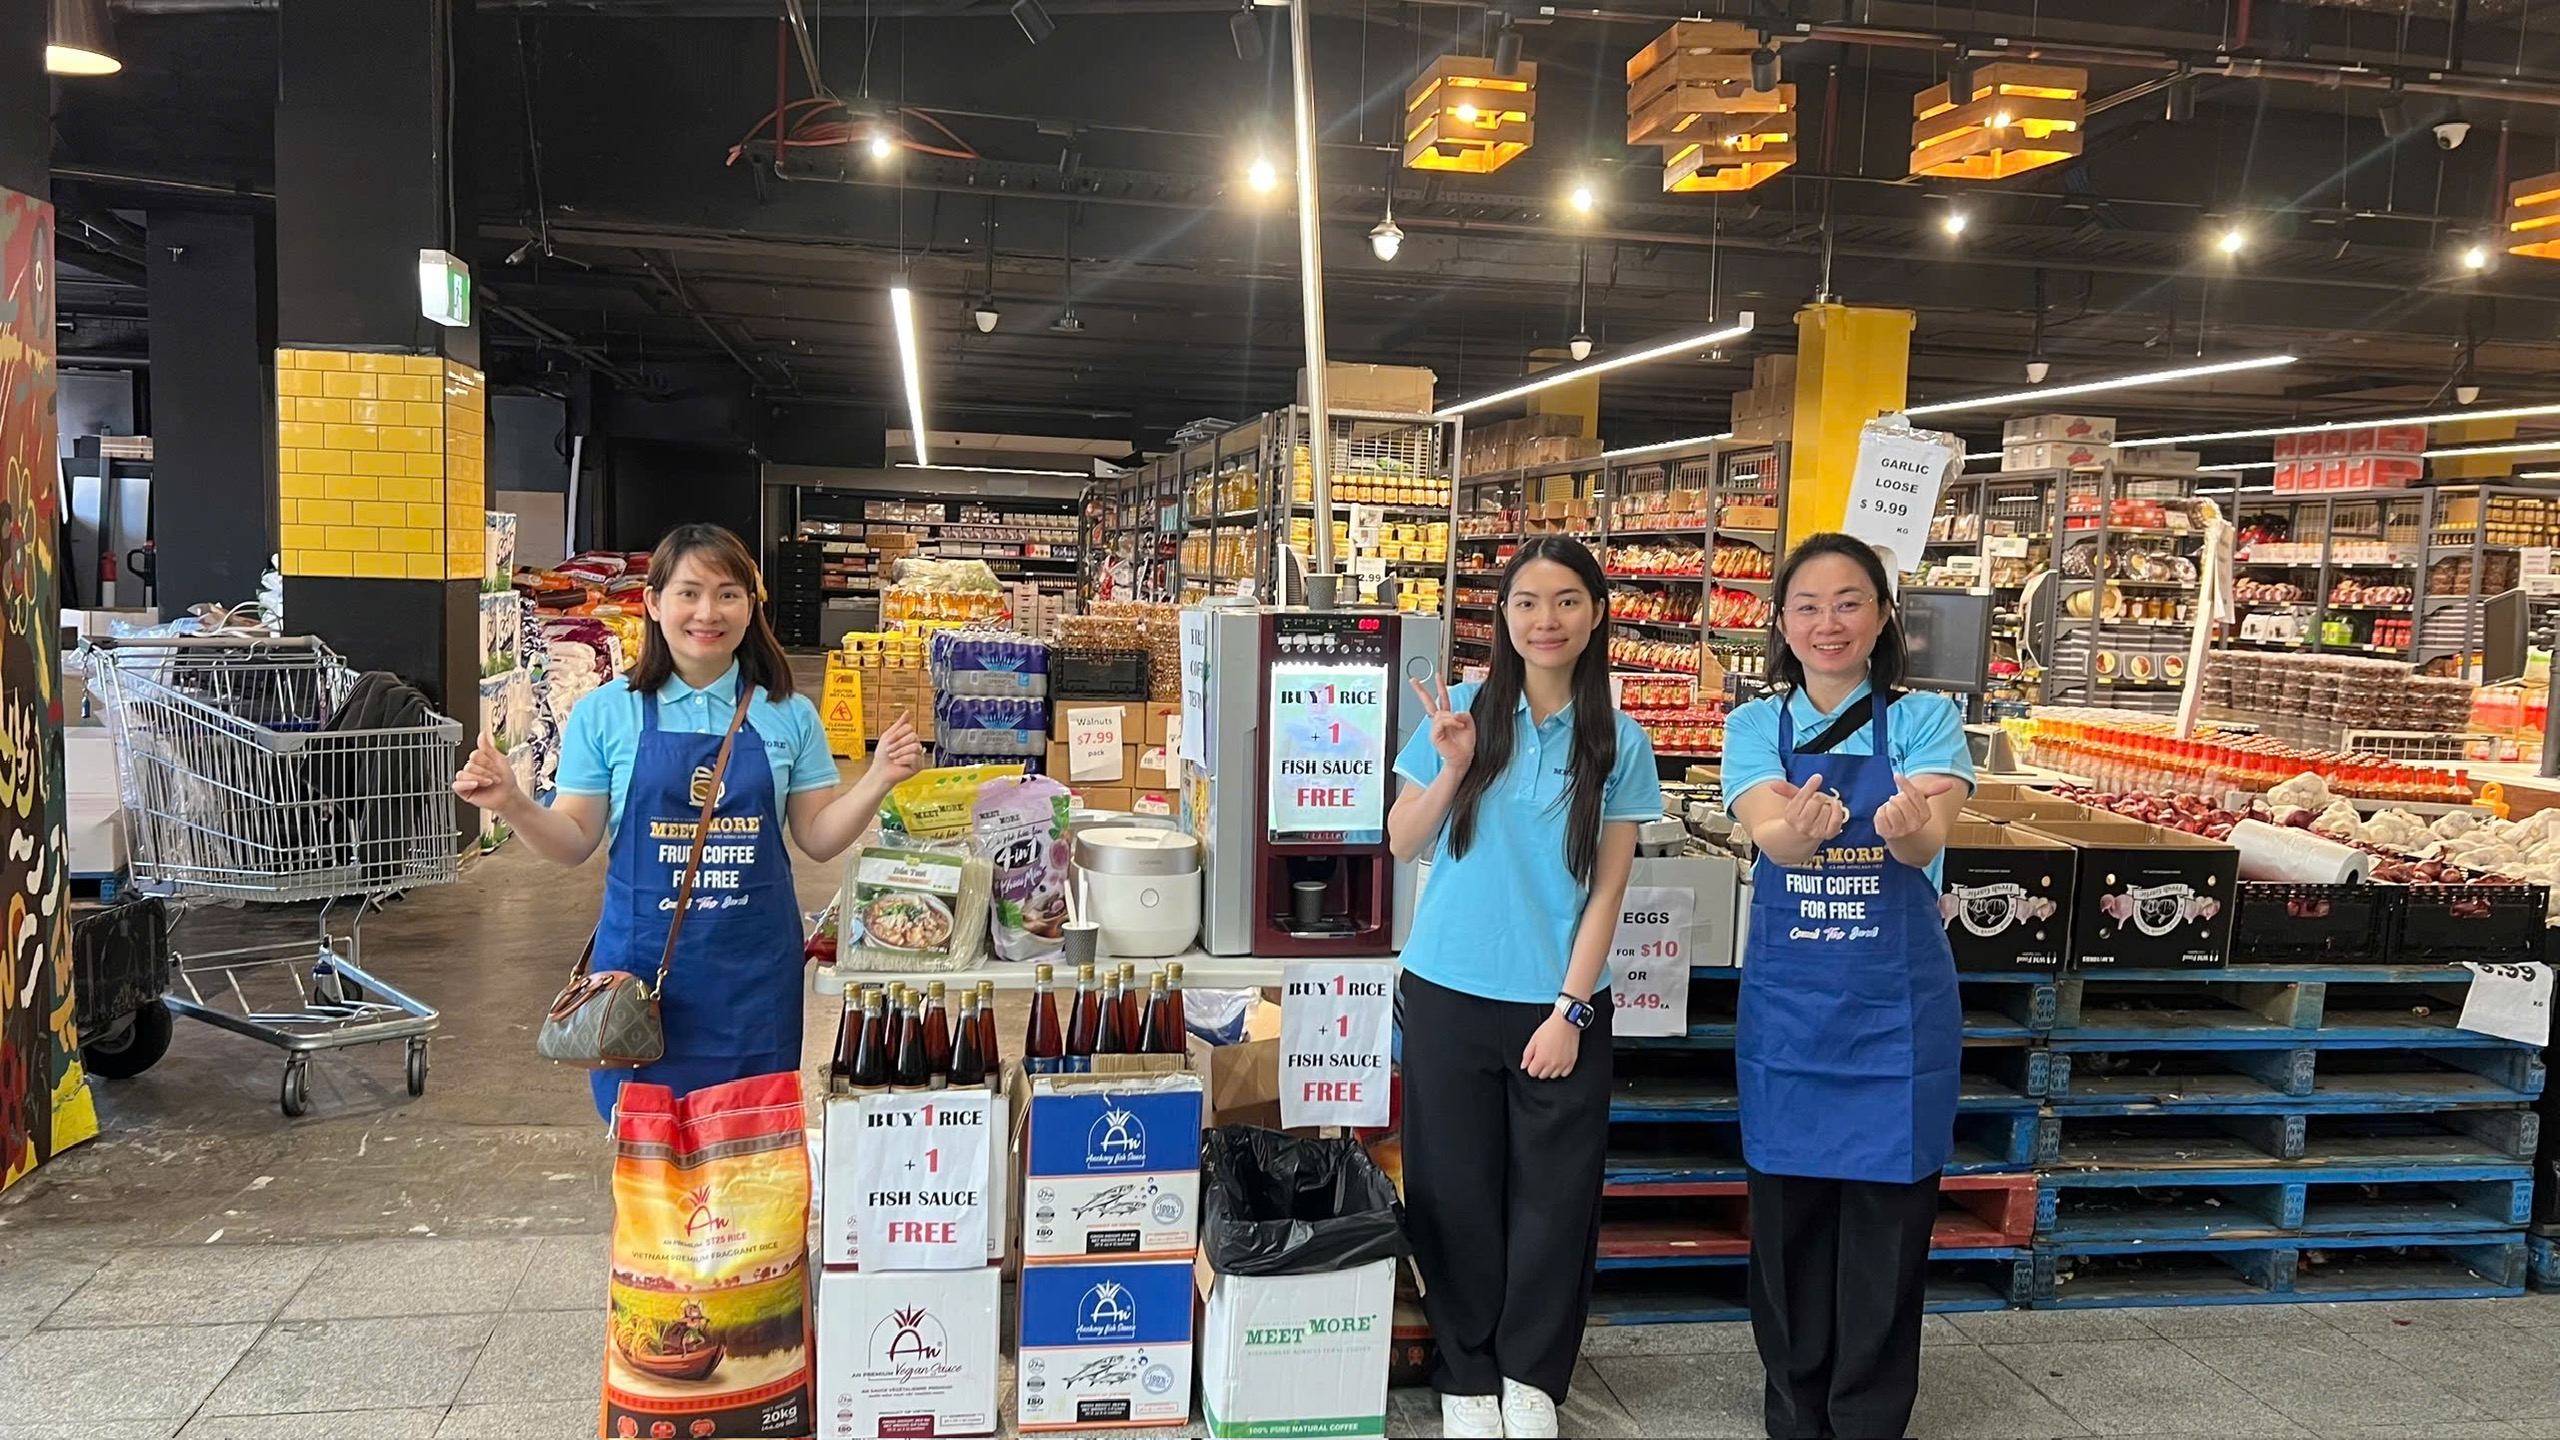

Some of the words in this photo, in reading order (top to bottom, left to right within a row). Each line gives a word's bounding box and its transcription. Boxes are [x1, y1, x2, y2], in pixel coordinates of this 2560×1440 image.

[1881, 458, 1930, 475] GARLIC
[1875, 478, 1919, 494] LOOSE
[1860, 499, 1868, 509] $
[1875, 500, 1907, 516] 9.99
[1896, 527, 1909, 535] KG
[1281, 690, 1322, 704] BUY
[1324, 684, 1335, 704] 1
[1340, 690, 1377, 705] RICE
[1077, 718, 1112, 726] Walnuts
[1077, 732, 1114, 745] $7.99
[1328, 723, 1339, 744] 1
[1281, 759, 1317, 775] FISH
[1322, 759, 1373, 775] SAUCE
[1297, 788, 1356, 807] FREE
[702, 845, 755, 864] COFFEE
[1826, 847, 1884, 863] MORE
[703, 870, 740, 888] FREE
[1786, 873, 1823, 894] FRUIT
[1826, 875, 1880, 895] COFFEE
[1623, 912, 1670, 924] EGGS
[1801, 901, 1826, 919] FOR
[1829, 901, 1866, 920] FREE
[1616, 949, 1635, 957] FOR
[1641, 941, 1678, 958] $10
[1627, 971, 1647, 981] OR
[1289, 982, 1330, 996] BUY
[1333, 975, 1344, 996] 1
[1349, 983, 1387, 997] RICE
[1336, 1015, 1348, 1037] 1
[1288, 1053, 1323, 1067] FISH
[1329, 1053, 1382, 1068] SAUCE
[1303, 1082, 1363, 1102] FREE
[868, 1112, 916, 1128] BUY
[921, 1104, 934, 1126] 1
[939, 1111, 983, 1126] RICE
[925, 1148, 938, 1172] 1
[869, 1191, 911, 1206] FISH
[918, 1191, 977, 1206] SAUCE
[727, 1232, 747, 1243] RICE
[888, 1222, 957, 1243] FREE
[632, 1251, 669, 1261] VIETNAM
[671, 1252, 709, 1263] PREMIUM
[711, 1246, 757, 1260] FRAGRANT
[759, 1241, 778, 1250] RICE
[1245, 1328, 1305, 1345] MEET
[1310, 1316, 1371, 1333] MORE
[895, 1362, 928, 1384] Vegan
[930, 1362, 963, 1377] Sauce
[762, 1405, 797, 1425] 20kg
[1292, 1424, 1328, 1433] NATURAL
[1329, 1423, 1359, 1431] COFFEE
